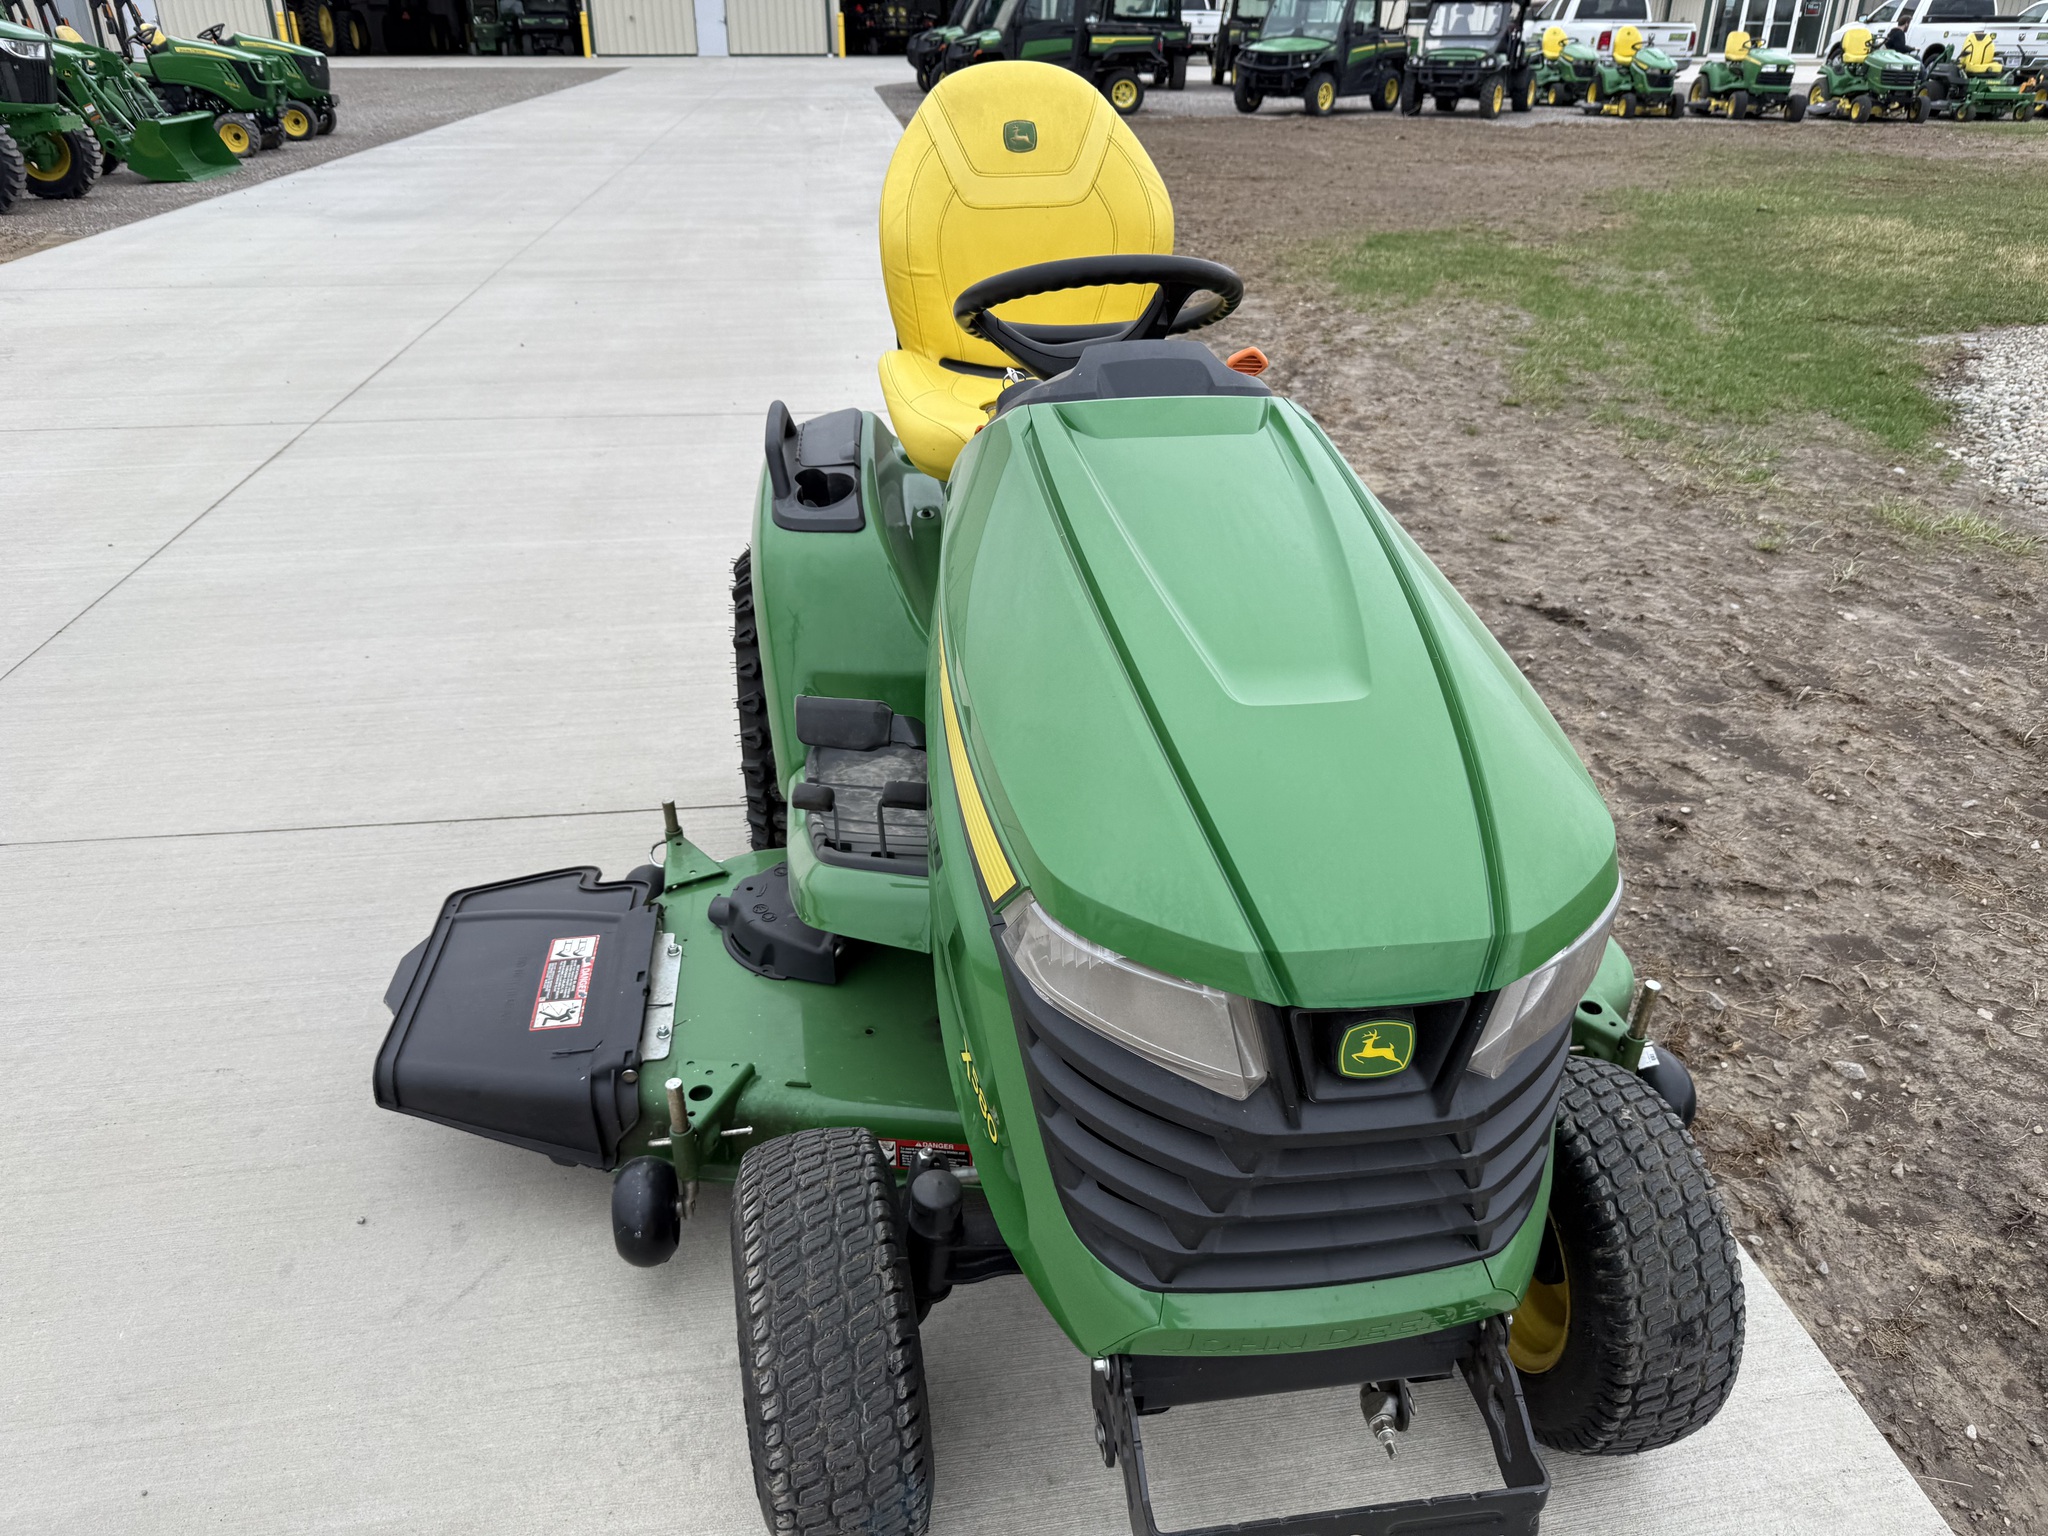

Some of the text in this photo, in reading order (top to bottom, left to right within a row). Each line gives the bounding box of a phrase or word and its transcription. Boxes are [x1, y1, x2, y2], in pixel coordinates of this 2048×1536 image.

[922, 1141, 954, 1150] DANGER
[1161, 1302, 1487, 1353] JOHN DEERE
